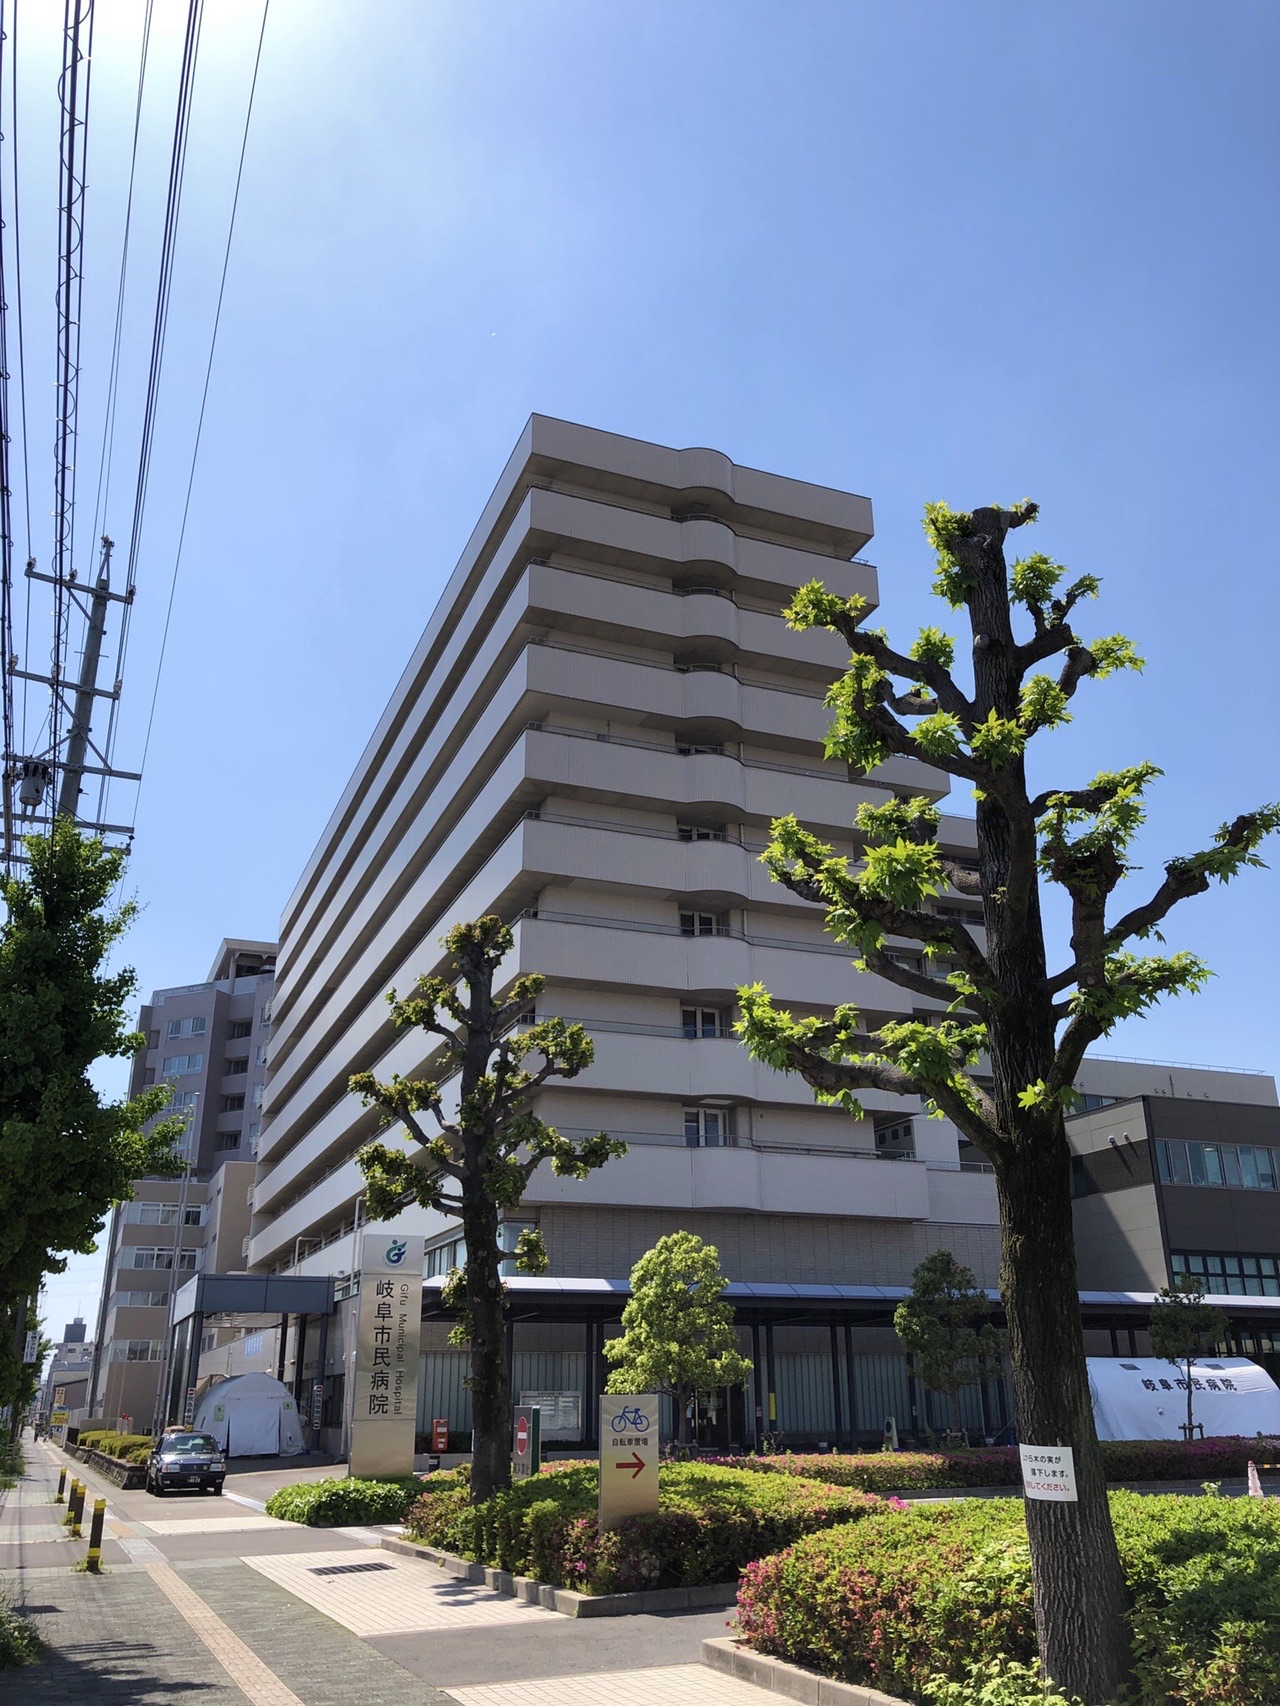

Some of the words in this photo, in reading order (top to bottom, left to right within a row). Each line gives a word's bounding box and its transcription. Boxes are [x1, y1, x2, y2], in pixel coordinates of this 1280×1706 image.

[400, 1283, 409, 1306] Gifu
[369, 1279, 395, 1415] 岐阜市民病院
[396, 1313, 407, 1363] Municipal
[393, 1370, 404, 1415] Hospital
[1141, 1378, 1238, 1391] 岐阜市民病院
[612, 1437, 648, 1446] 自転車置場
[1030, 1467, 1069, 1478] 落下します。
